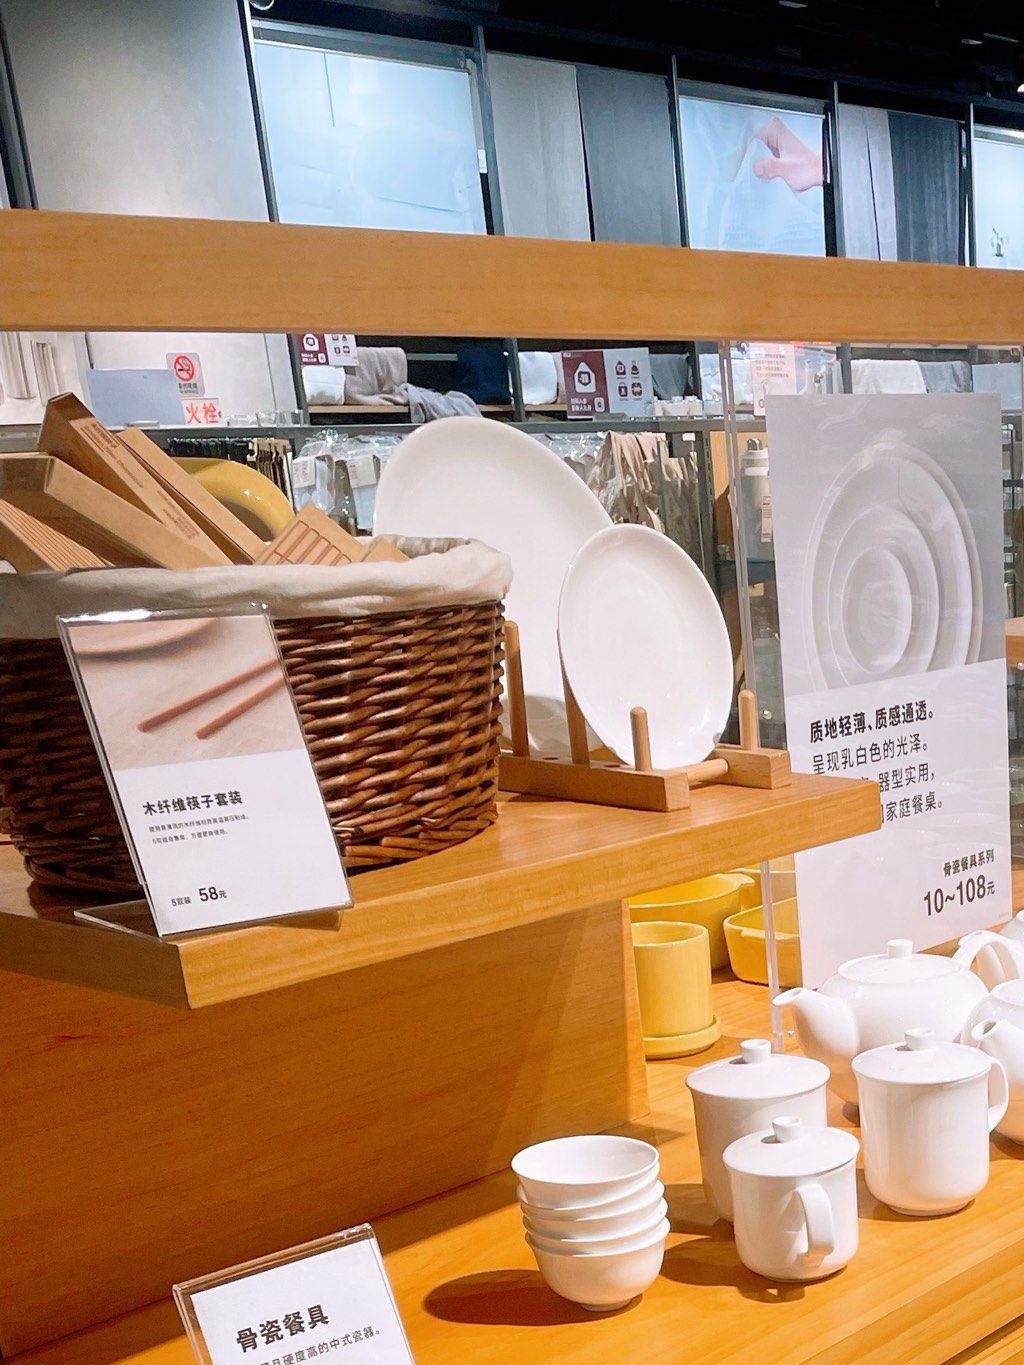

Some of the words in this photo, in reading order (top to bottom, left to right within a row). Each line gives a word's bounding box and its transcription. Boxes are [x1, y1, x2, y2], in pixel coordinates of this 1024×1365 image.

[810, 700, 934, 744] 质地轻薄、质感通透。
[813, 733, 928, 775] 呈现乳白色的光泽。
[143, 790, 243, 816] 木纤维筷子套装
[881, 791, 943, 824] 家庭餐桌。
[943, 848, 995, 877] 骨瓷餐具系列
[199, 886, 227, 902] 58元
[236, 1304, 330, 1353] 骨瓷餐具
